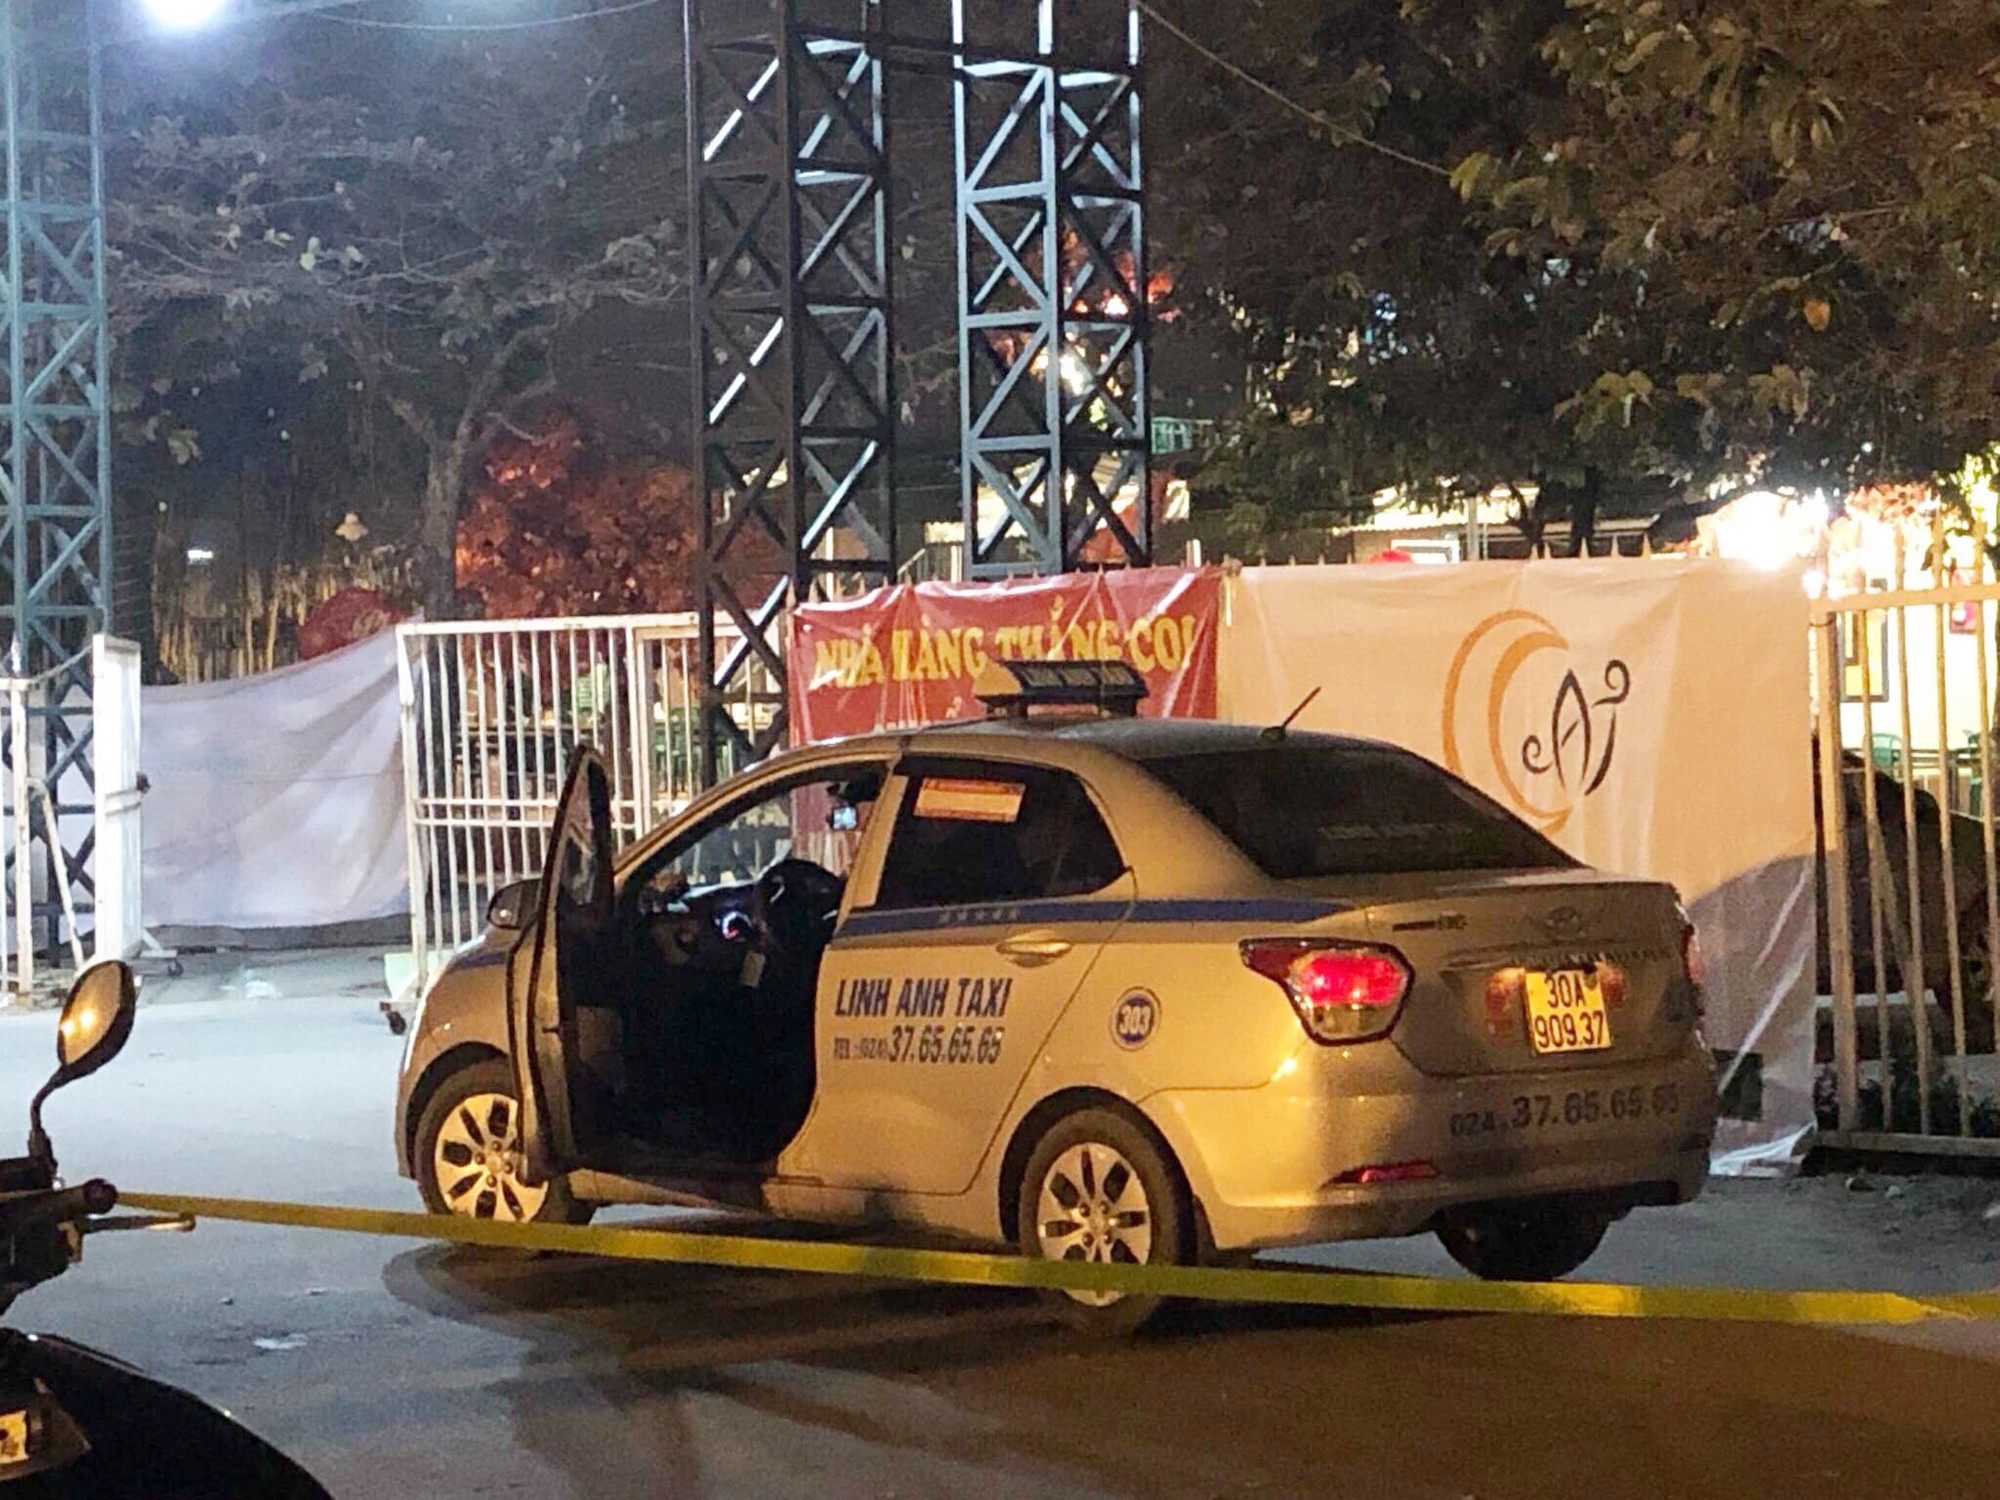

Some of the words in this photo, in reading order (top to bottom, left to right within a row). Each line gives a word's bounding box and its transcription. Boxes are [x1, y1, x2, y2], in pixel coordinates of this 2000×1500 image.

[834, 978, 893, 1018] LINH
[895, 978, 950, 1018] ANH
[954, 977, 1014, 1018] TAXI
[1544, 972, 1587, 1008] 30A
[1535, 1009, 1604, 1048] 909.37
